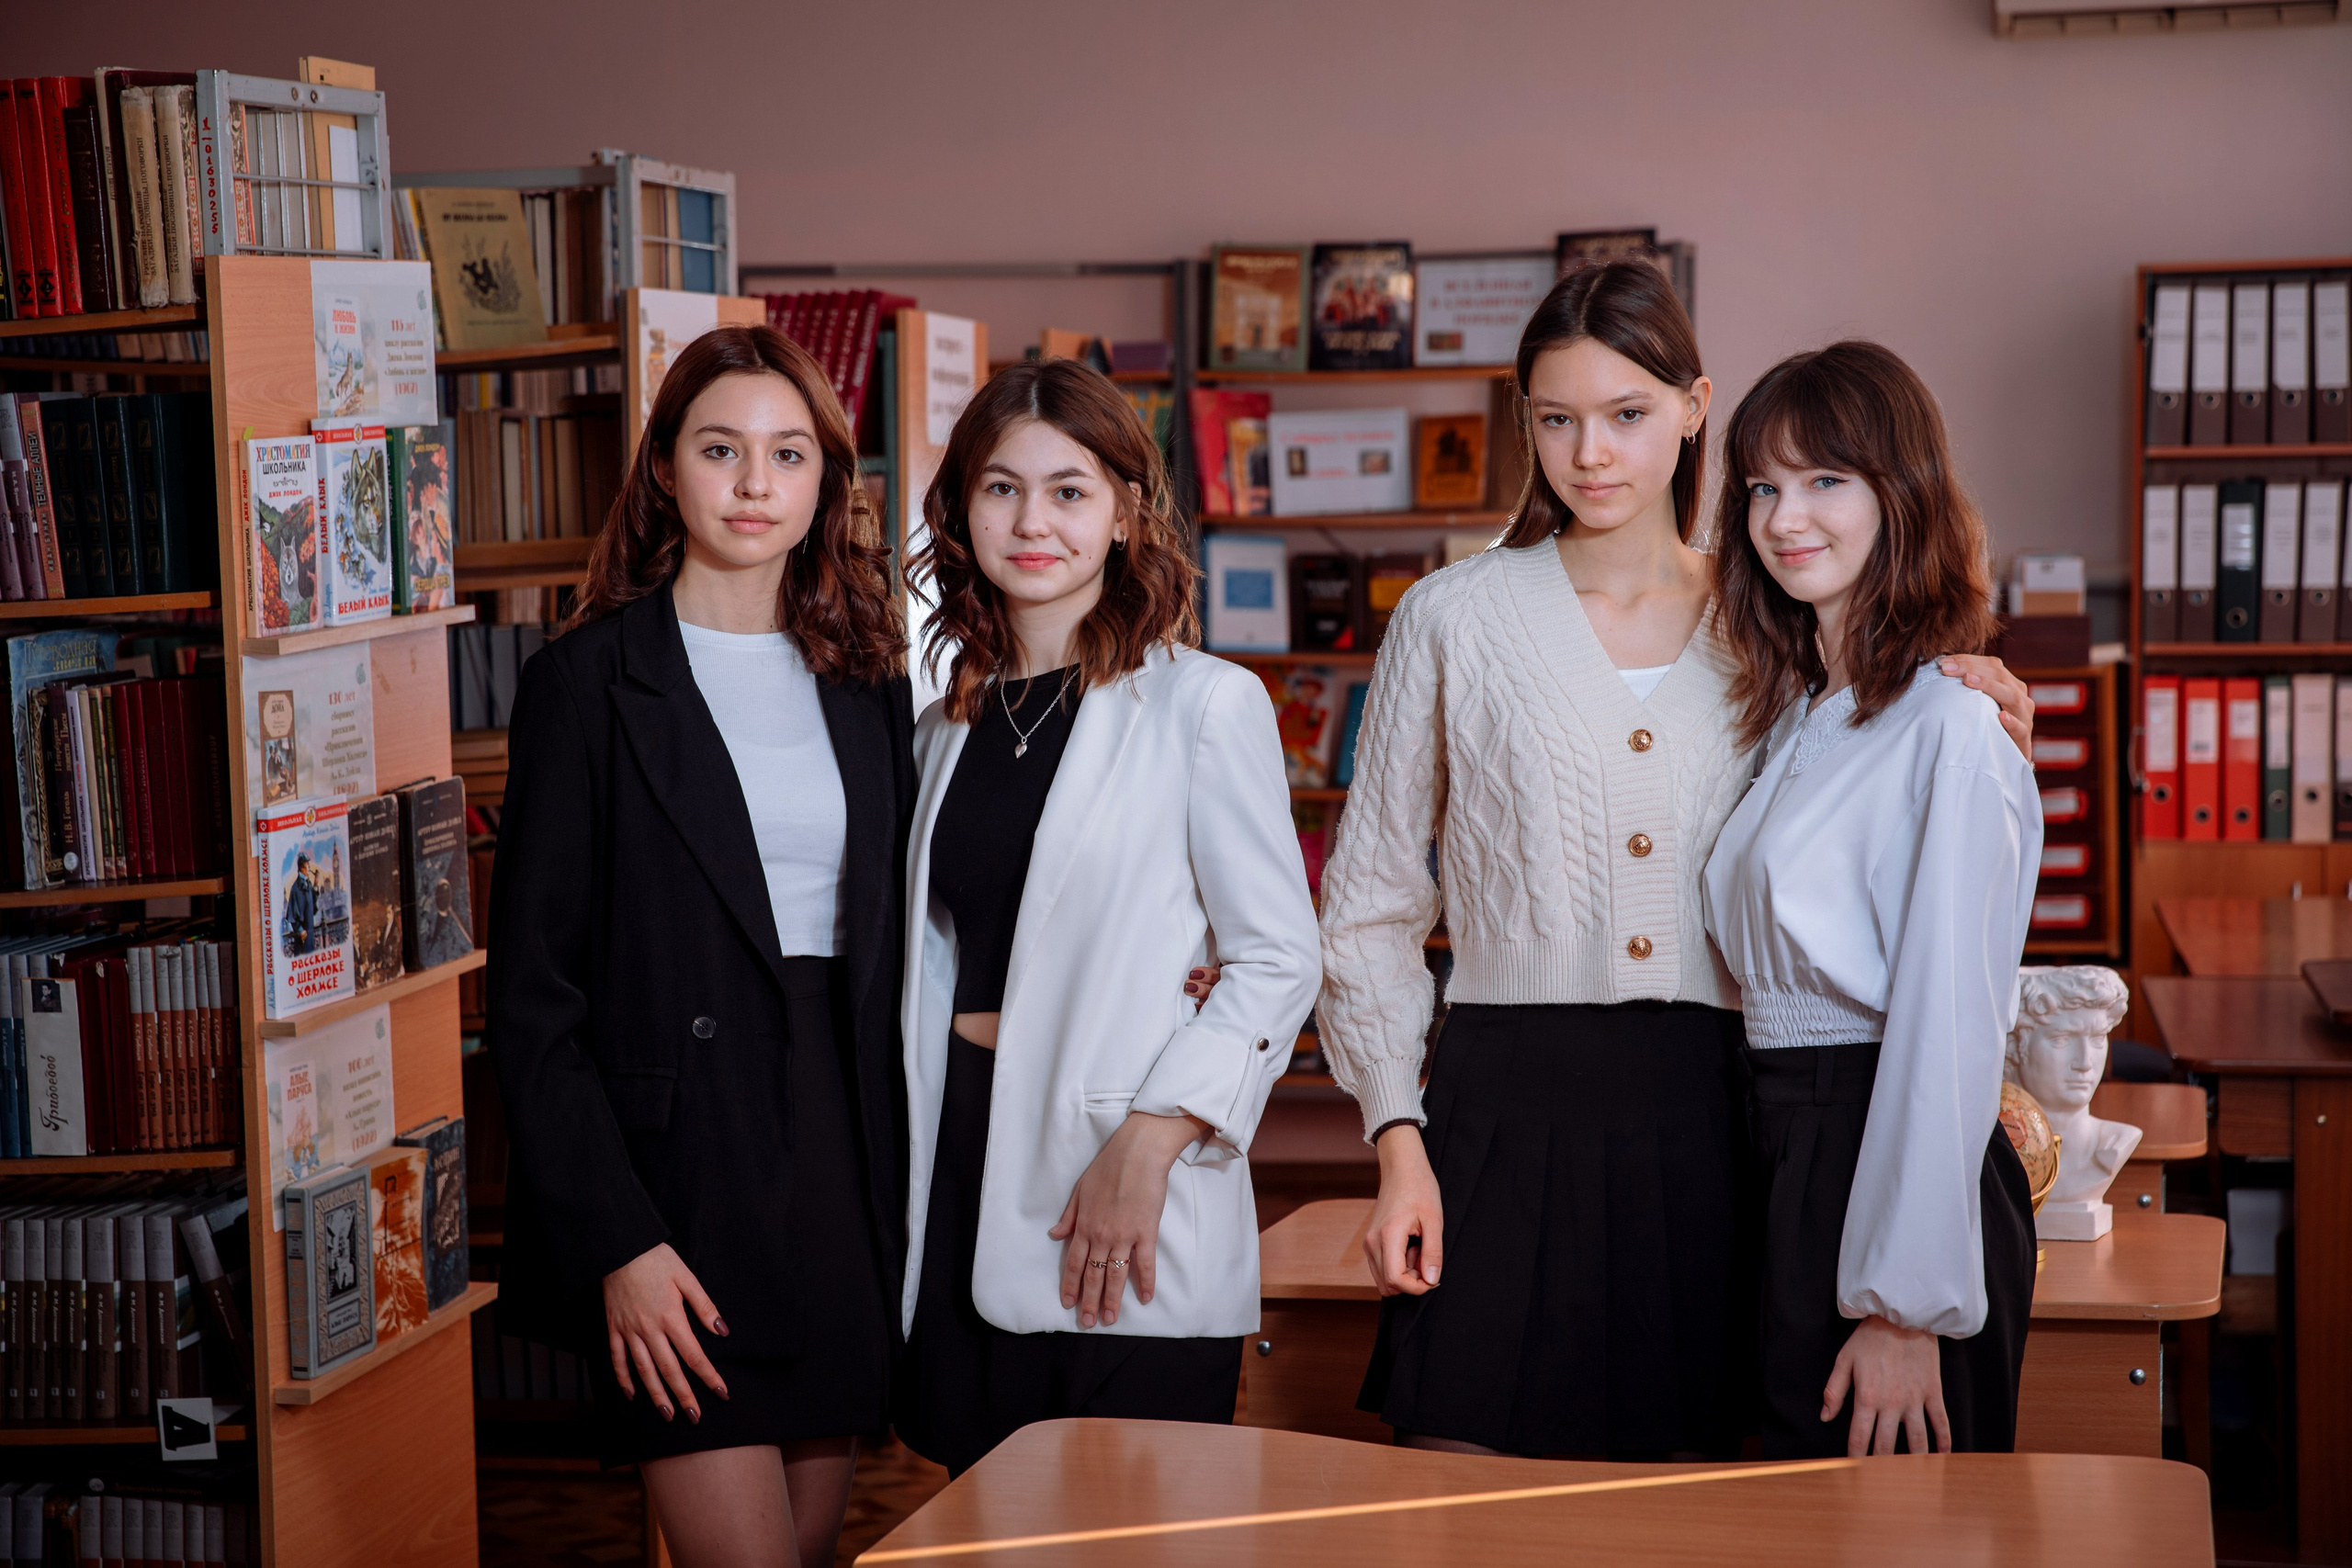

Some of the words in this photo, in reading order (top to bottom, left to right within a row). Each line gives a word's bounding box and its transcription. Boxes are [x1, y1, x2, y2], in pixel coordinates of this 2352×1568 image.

[139, 138, 147, 185] ПОГОВОРКИ
[137, 190, 146, 236] НАРОДНЫЕ
[141, 238, 150, 276] РУССКИЕ
[333, 309, 356, 323] ЛЮБОВЬ
[339, 324, 356, 334] ЖИЗНИ
[391, 320, 403, 332] 115
[28, 432, 40, 465] АЛЛЕИ
[256, 444, 311, 462] ХРЕСТОМАТИЯ
[262, 461, 306, 474] ШКОЛЬНИКА
[34, 467, 46, 508] ТЕМНЫЕ
[318, 478, 327, 510] КЛЫК
[41, 513, 51, 543] БУНИН
[46, 546, 55, 571] ИВАН
[414, 578, 435, 592] СЕРДЦА
[338, 595, 366, 615] БЕЛЫЙ
[368, 594, 390, 608] КЛЫК
[328, 692, 343, 705] 130
[51, 717, 64, 772] Петербургские
[61, 790, 72, 820] Гоголь
[78, 795, 87, 832] ШКОЛЬНИКА
[63, 820, 73, 831] В.
[64, 833, 74, 843] Н.
[82, 834, 91, 876] ХРЕСТОМАТИЯ
[261, 839, 269, 874] ХОЛМСЕ
[262, 876, 271, 918] ШЕРЛОКЕ
[288, 976, 294, 987] О
[297, 960, 345, 984] ШЕРЛОКЕ
[297, 976, 338, 998] ХОЛМСЕ
[137, 1071, 145, 1089] Горе
[148, 1071, 156, 1089] Горе
[164, 1069, 173, 1088] Горе
[177, 1068, 186, 1087] Горе
[201, 1066, 209, 1084] Горе
[290, 1071, 309, 1087] АЛЫЕ
[139, 1092, 144, 1100] от
[151, 1091, 156, 1100] от
[166, 1089, 172, 1099] от
[180, 1089, 186, 1099] от
[192, 1089, 197, 1098] от
[203, 1087, 209, 1096] от
[287, 1083, 312, 1101] ПАРУСА
